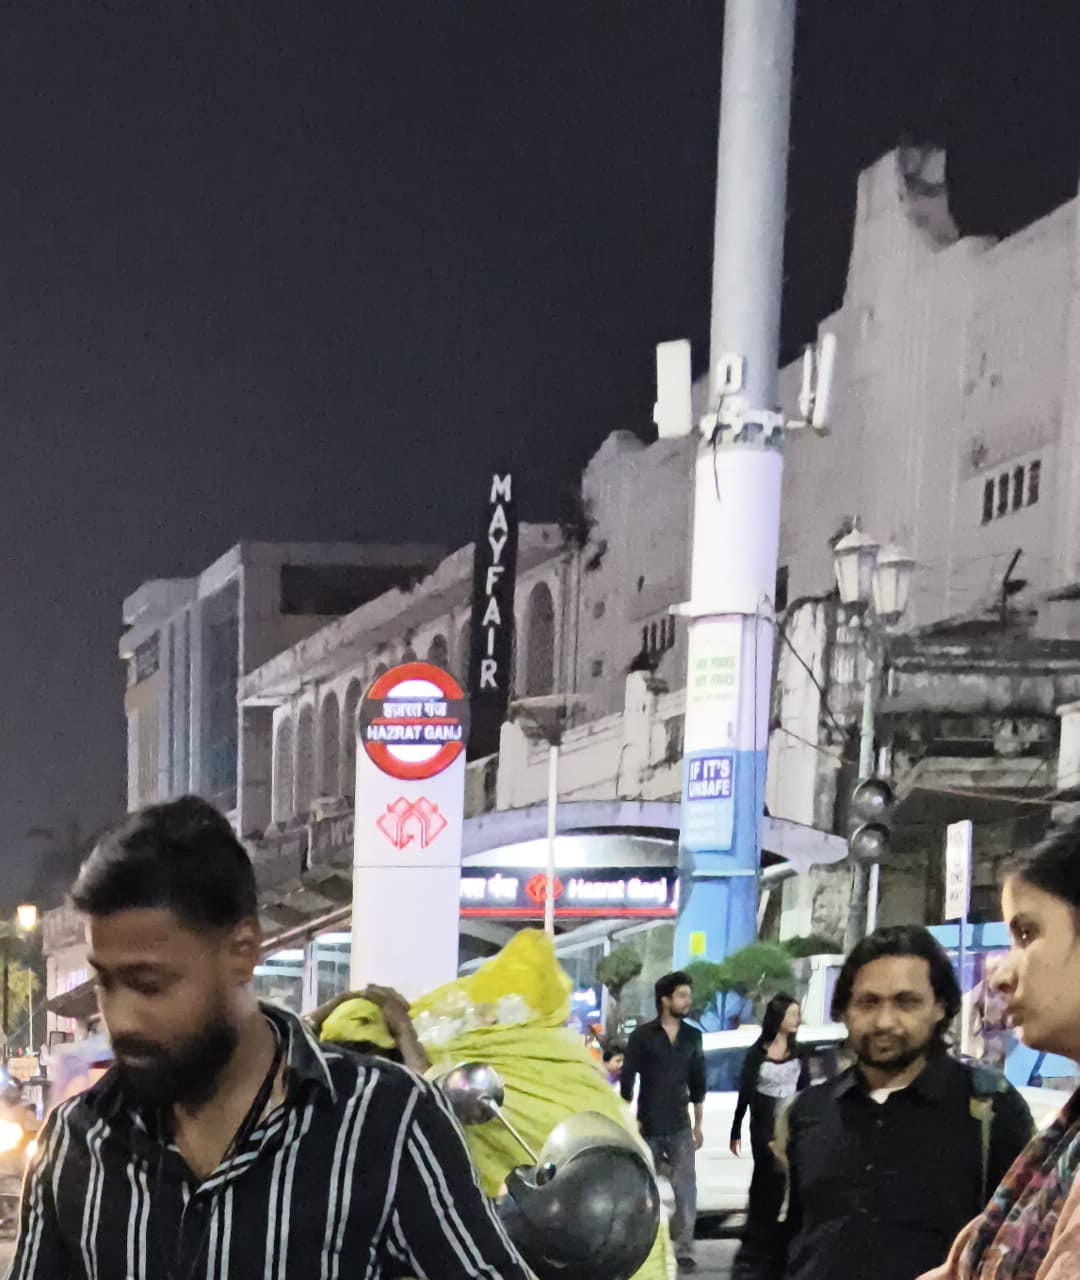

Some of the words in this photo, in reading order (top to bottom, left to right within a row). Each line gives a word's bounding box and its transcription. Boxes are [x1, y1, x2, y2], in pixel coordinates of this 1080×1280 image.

[480, 473, 512, 689] MAYFAIR
[366, 725, 423, 740] HAZRAT
[424, 725, 463, 740] GANJ
[689, 760, 699, 780] IF
[702, 758, 731, 778] IT'S
[688, 780, 731, 798] UNSAFE
